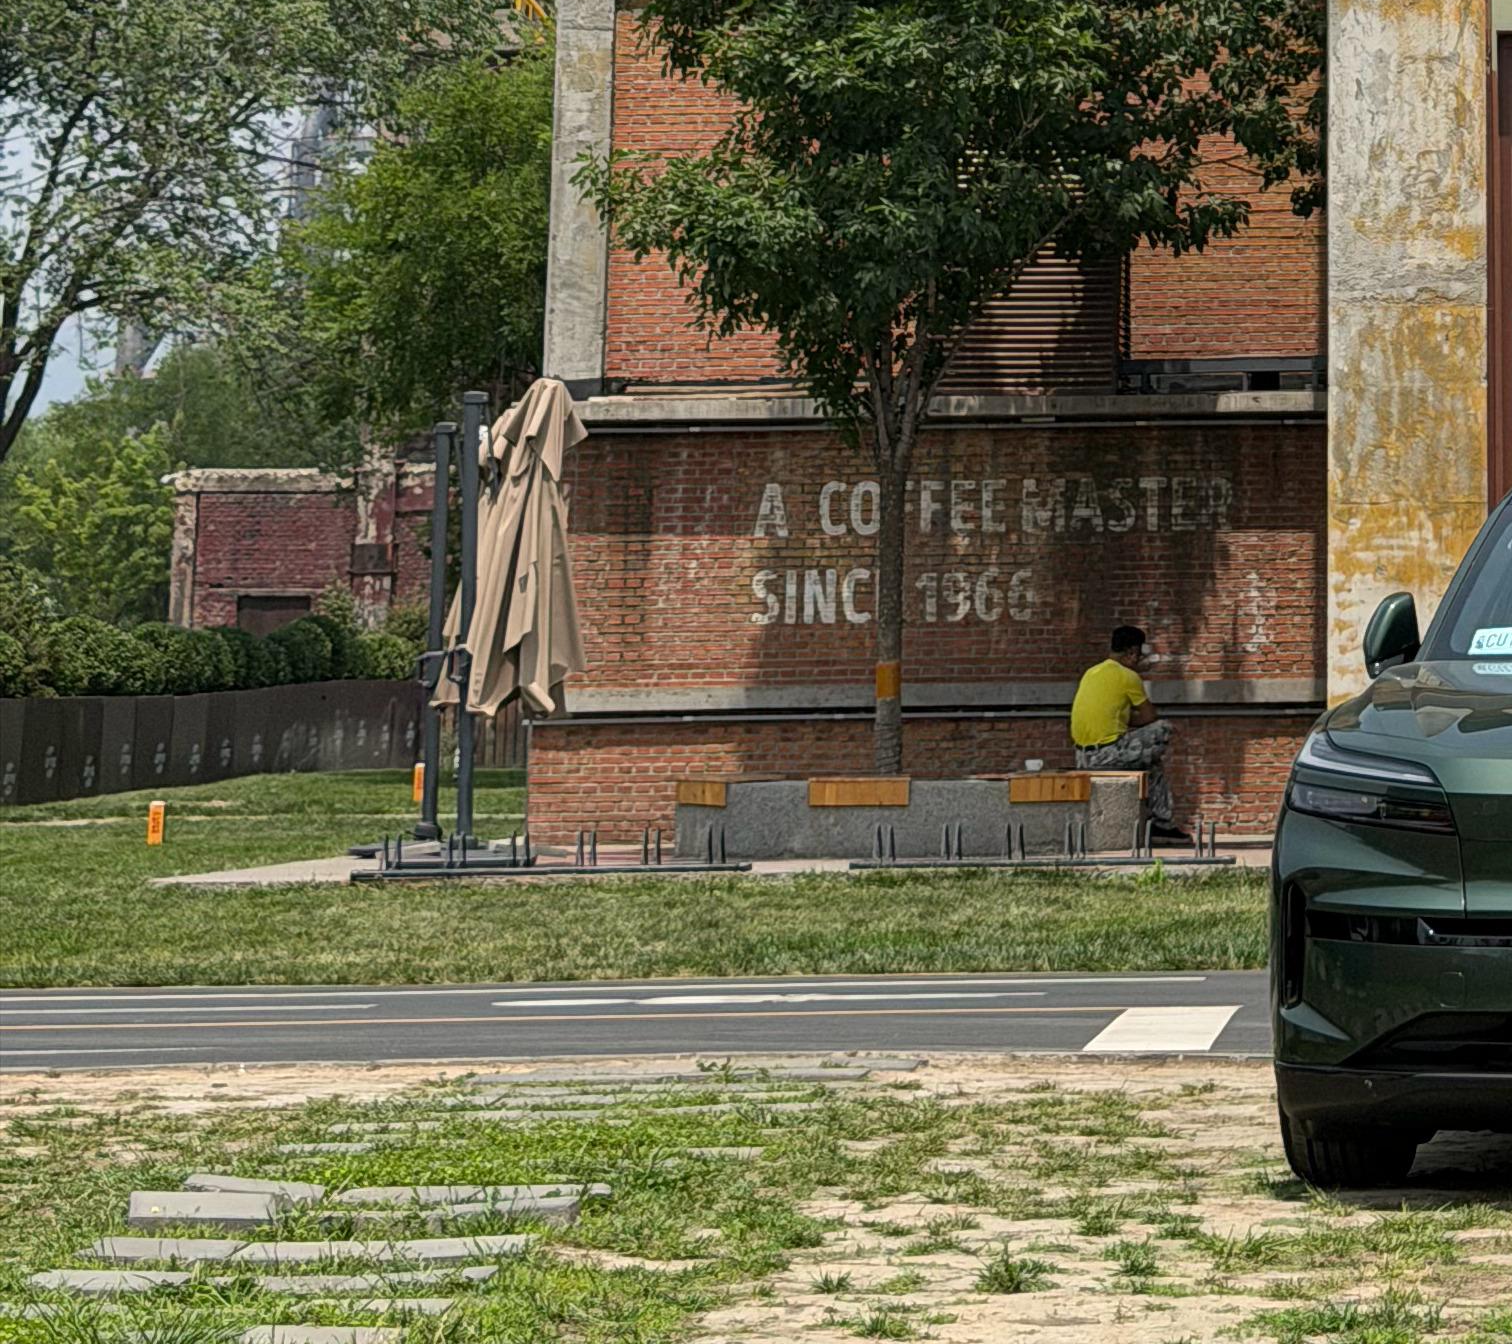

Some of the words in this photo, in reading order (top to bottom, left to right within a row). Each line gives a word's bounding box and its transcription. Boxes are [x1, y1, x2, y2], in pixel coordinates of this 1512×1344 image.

[753, 483, 789, 537] A
[818, 479, 1007, 536] COFEE
[1021, 476, 1234, 533] MASTER
[750, 568, 881, 626] SINC
[914, 568, 1036, 624] 1966
